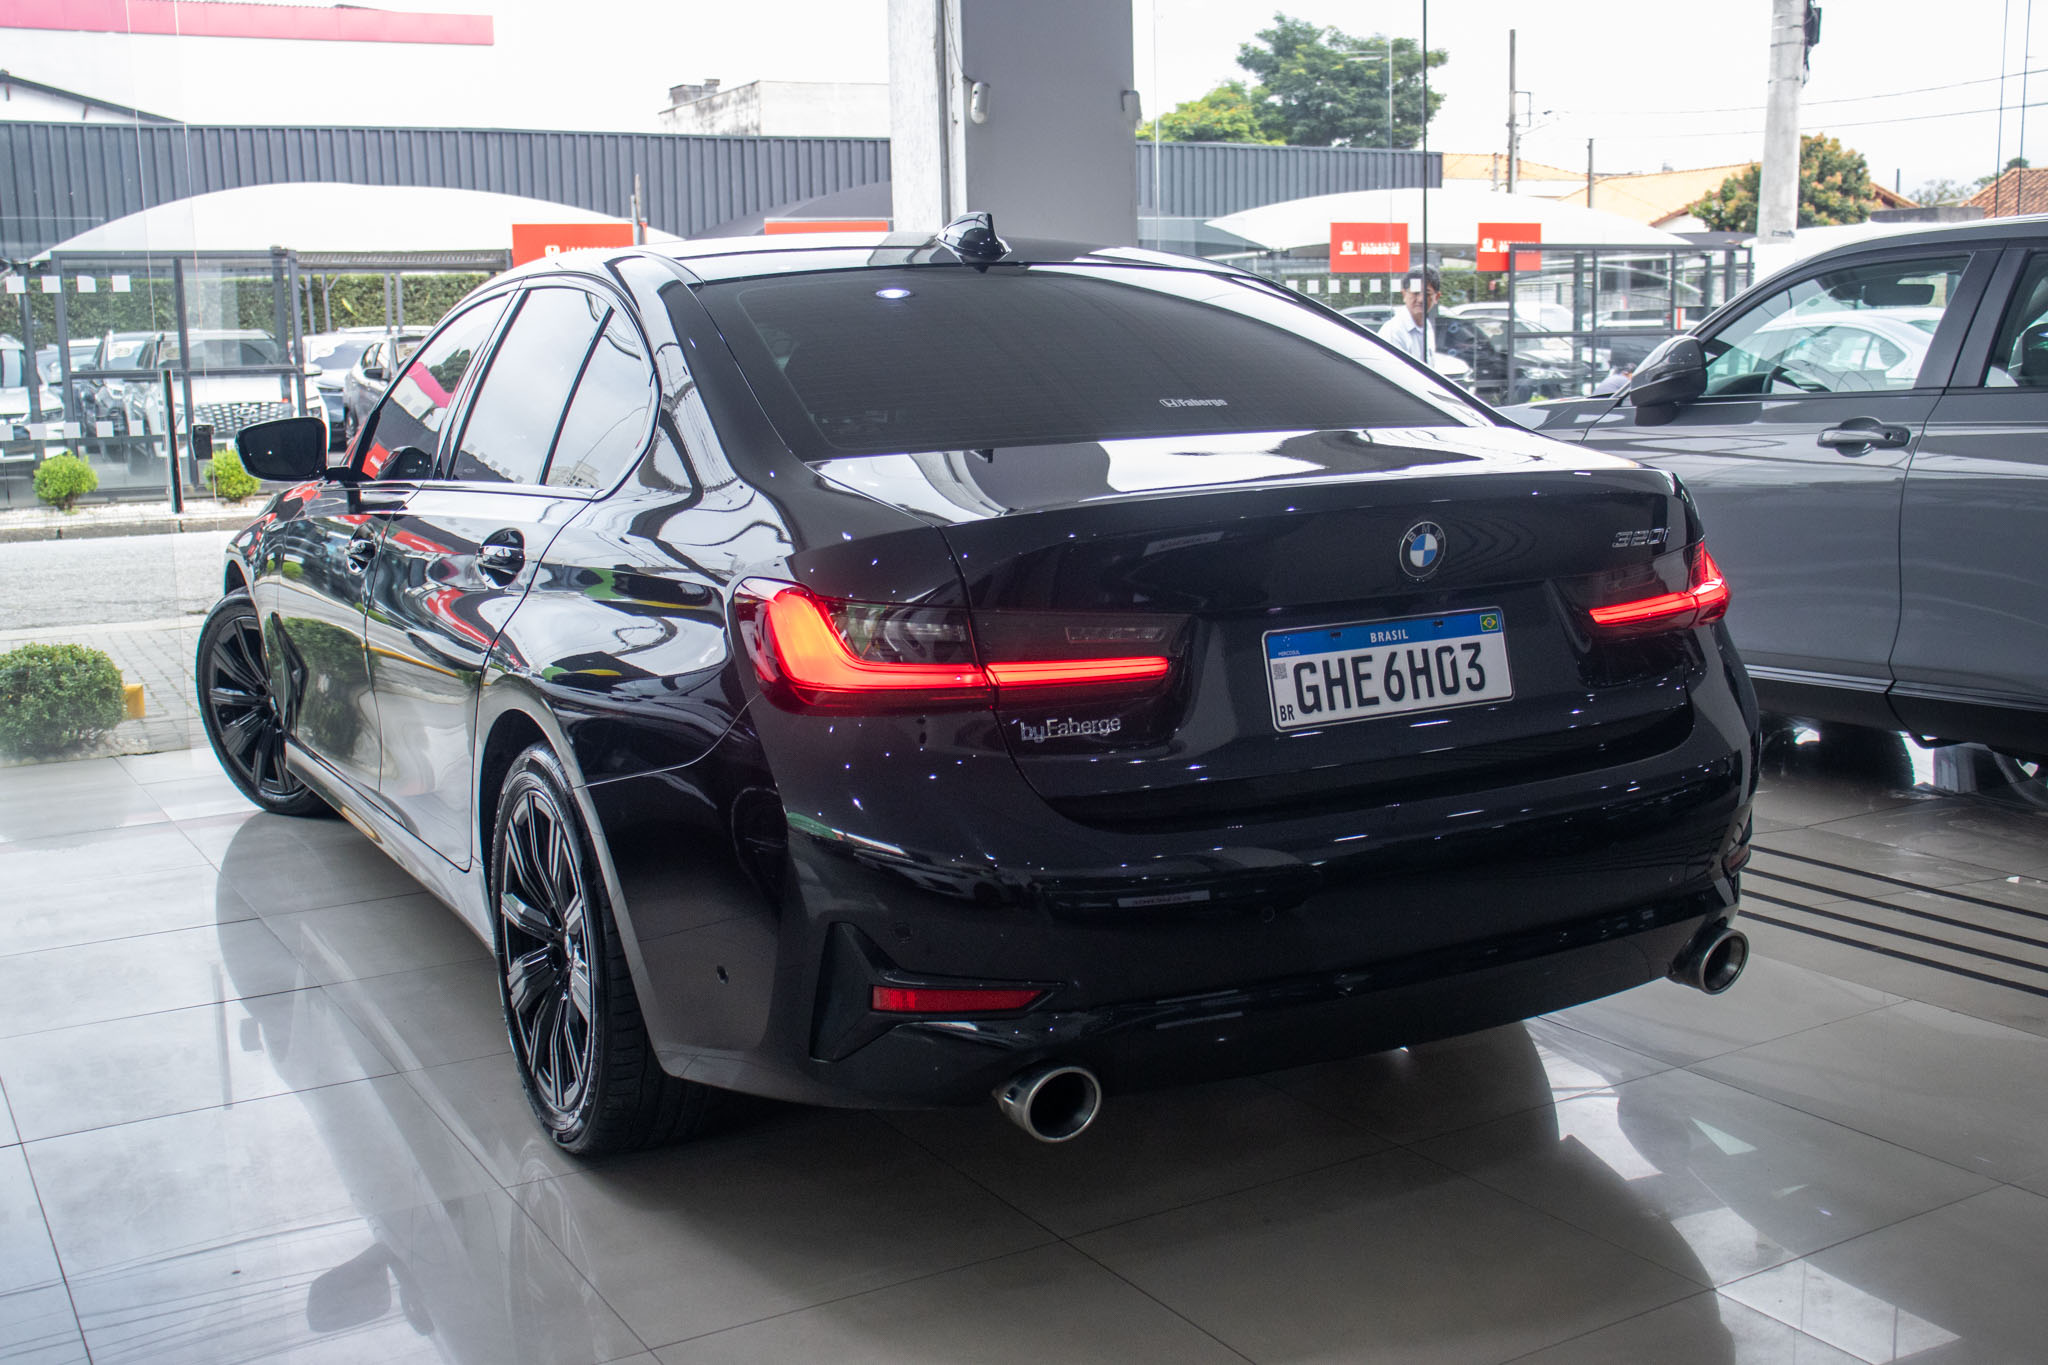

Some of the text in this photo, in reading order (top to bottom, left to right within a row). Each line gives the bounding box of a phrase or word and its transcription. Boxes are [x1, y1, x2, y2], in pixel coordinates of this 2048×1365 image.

[1370, 629, 1409, 643] BRASIL
[1293, 641, 1486, 714] GHE6H03
[1279, 704, 1295, 722] BR
